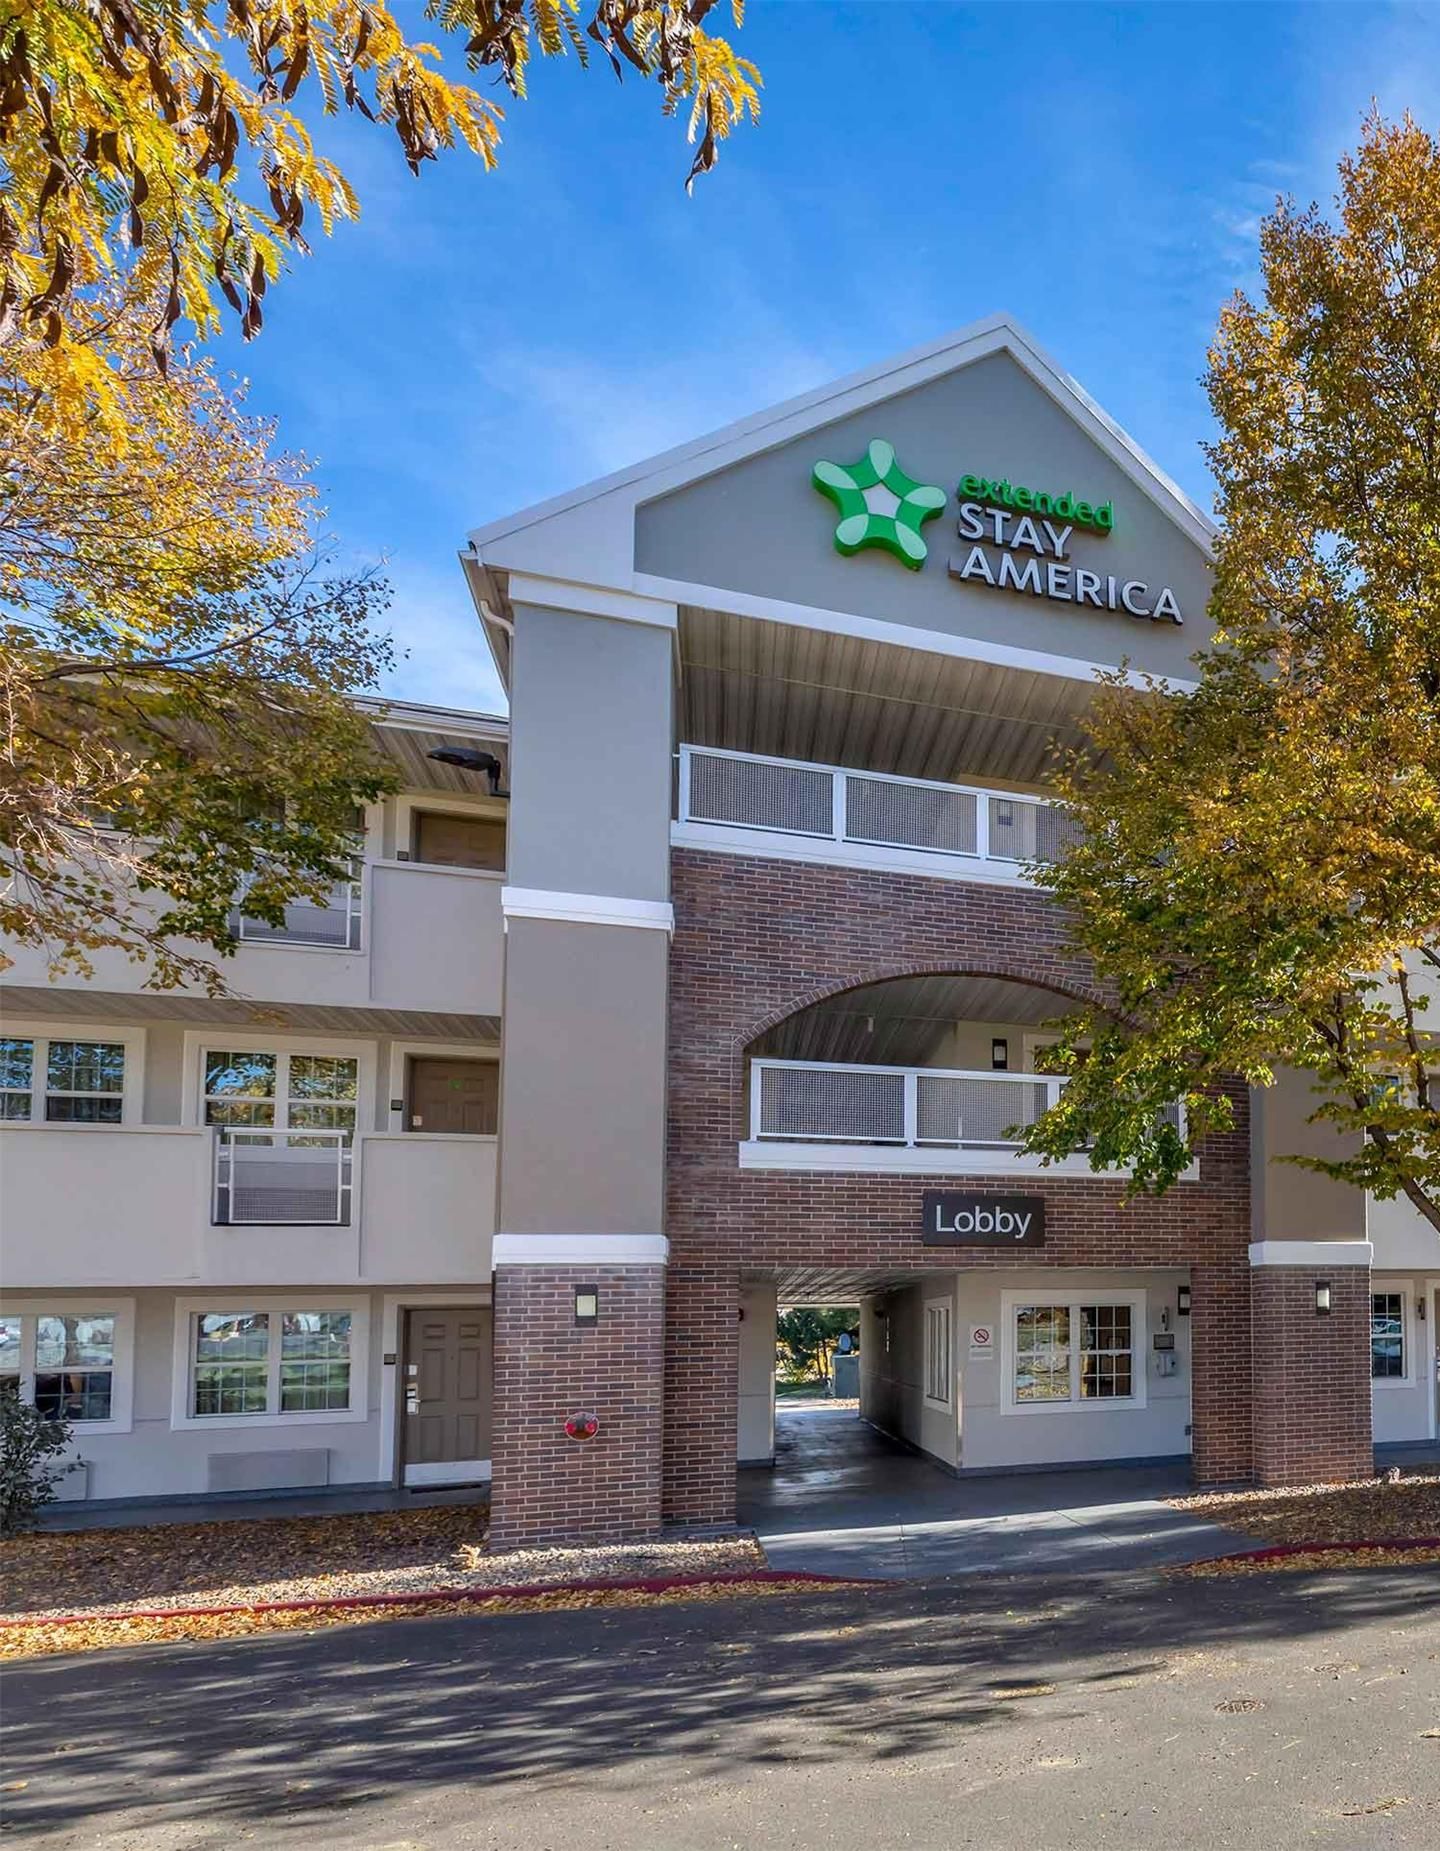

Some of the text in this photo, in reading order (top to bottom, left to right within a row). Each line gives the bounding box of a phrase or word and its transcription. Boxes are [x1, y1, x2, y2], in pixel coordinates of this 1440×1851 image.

[959, 474, 1114, 530] extended
[959, 502, 1073, 559] STAY
[960, 546, 1183, 624] AMERICA
[936, 1204, 1032, 1239] Lobby
